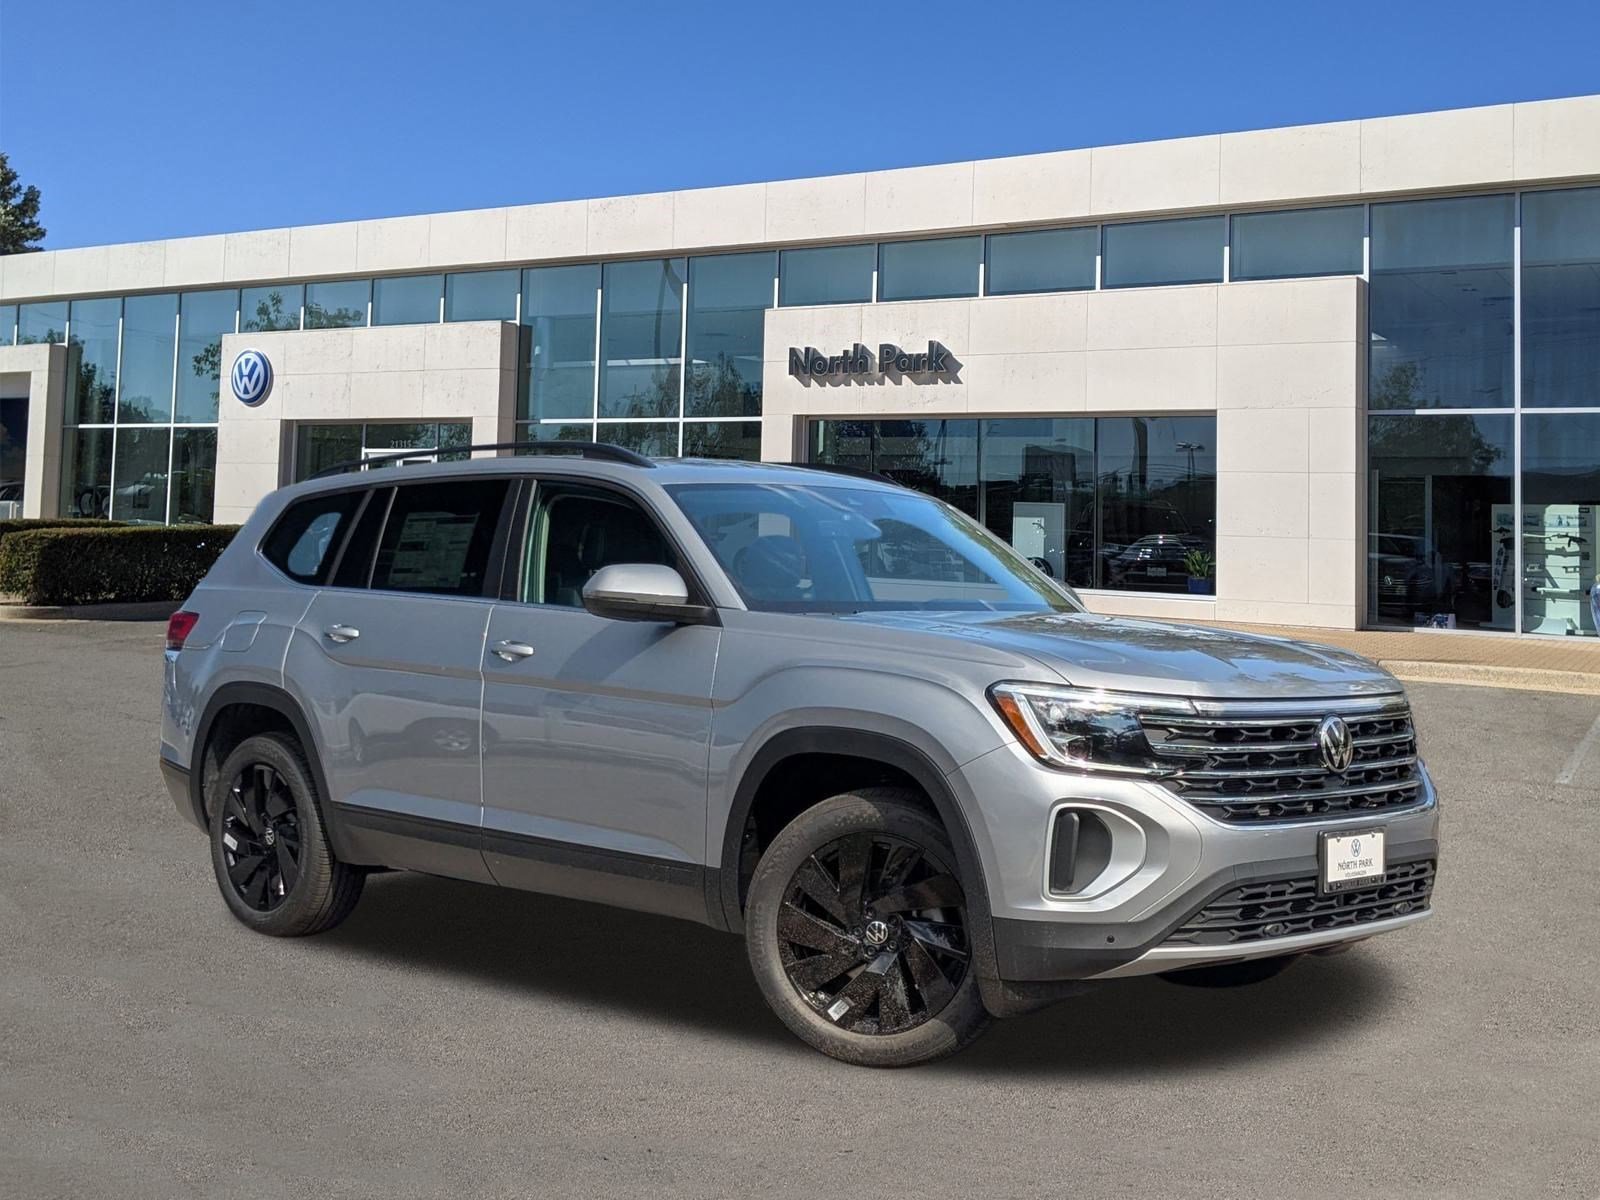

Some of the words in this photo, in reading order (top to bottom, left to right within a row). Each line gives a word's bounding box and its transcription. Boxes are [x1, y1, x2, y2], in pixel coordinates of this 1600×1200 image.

[788, 342, 871, 376] North
[879, 340, 949, 373] Park
[232, 351, 267, 402] VW
[1337, 859, 1358, 871] NORTH
[1358, 858, 1374, 869] PARK
